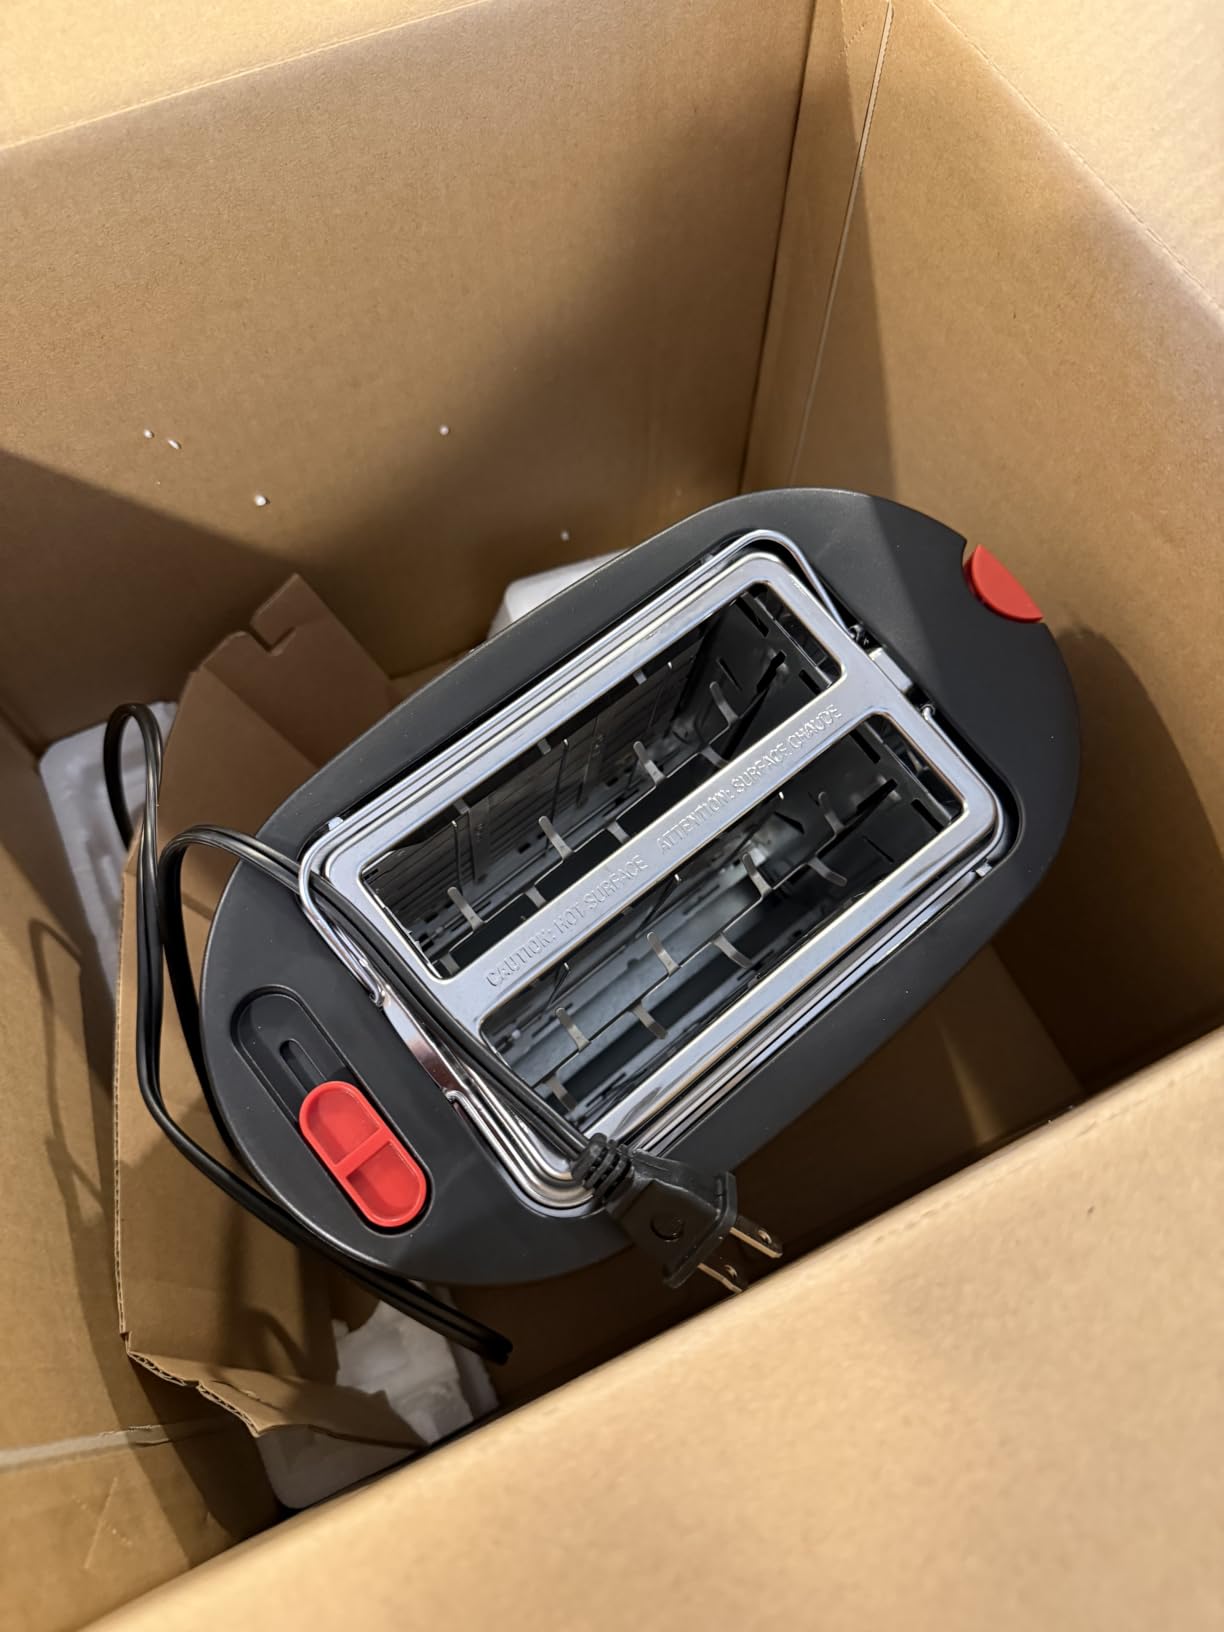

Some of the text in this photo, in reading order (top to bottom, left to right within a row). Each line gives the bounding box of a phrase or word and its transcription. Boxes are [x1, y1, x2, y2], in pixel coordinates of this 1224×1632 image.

[486, 703, 842, 987] CAUTION: HOT SURFACE ATTENTION: SURFACE CHAUDE
